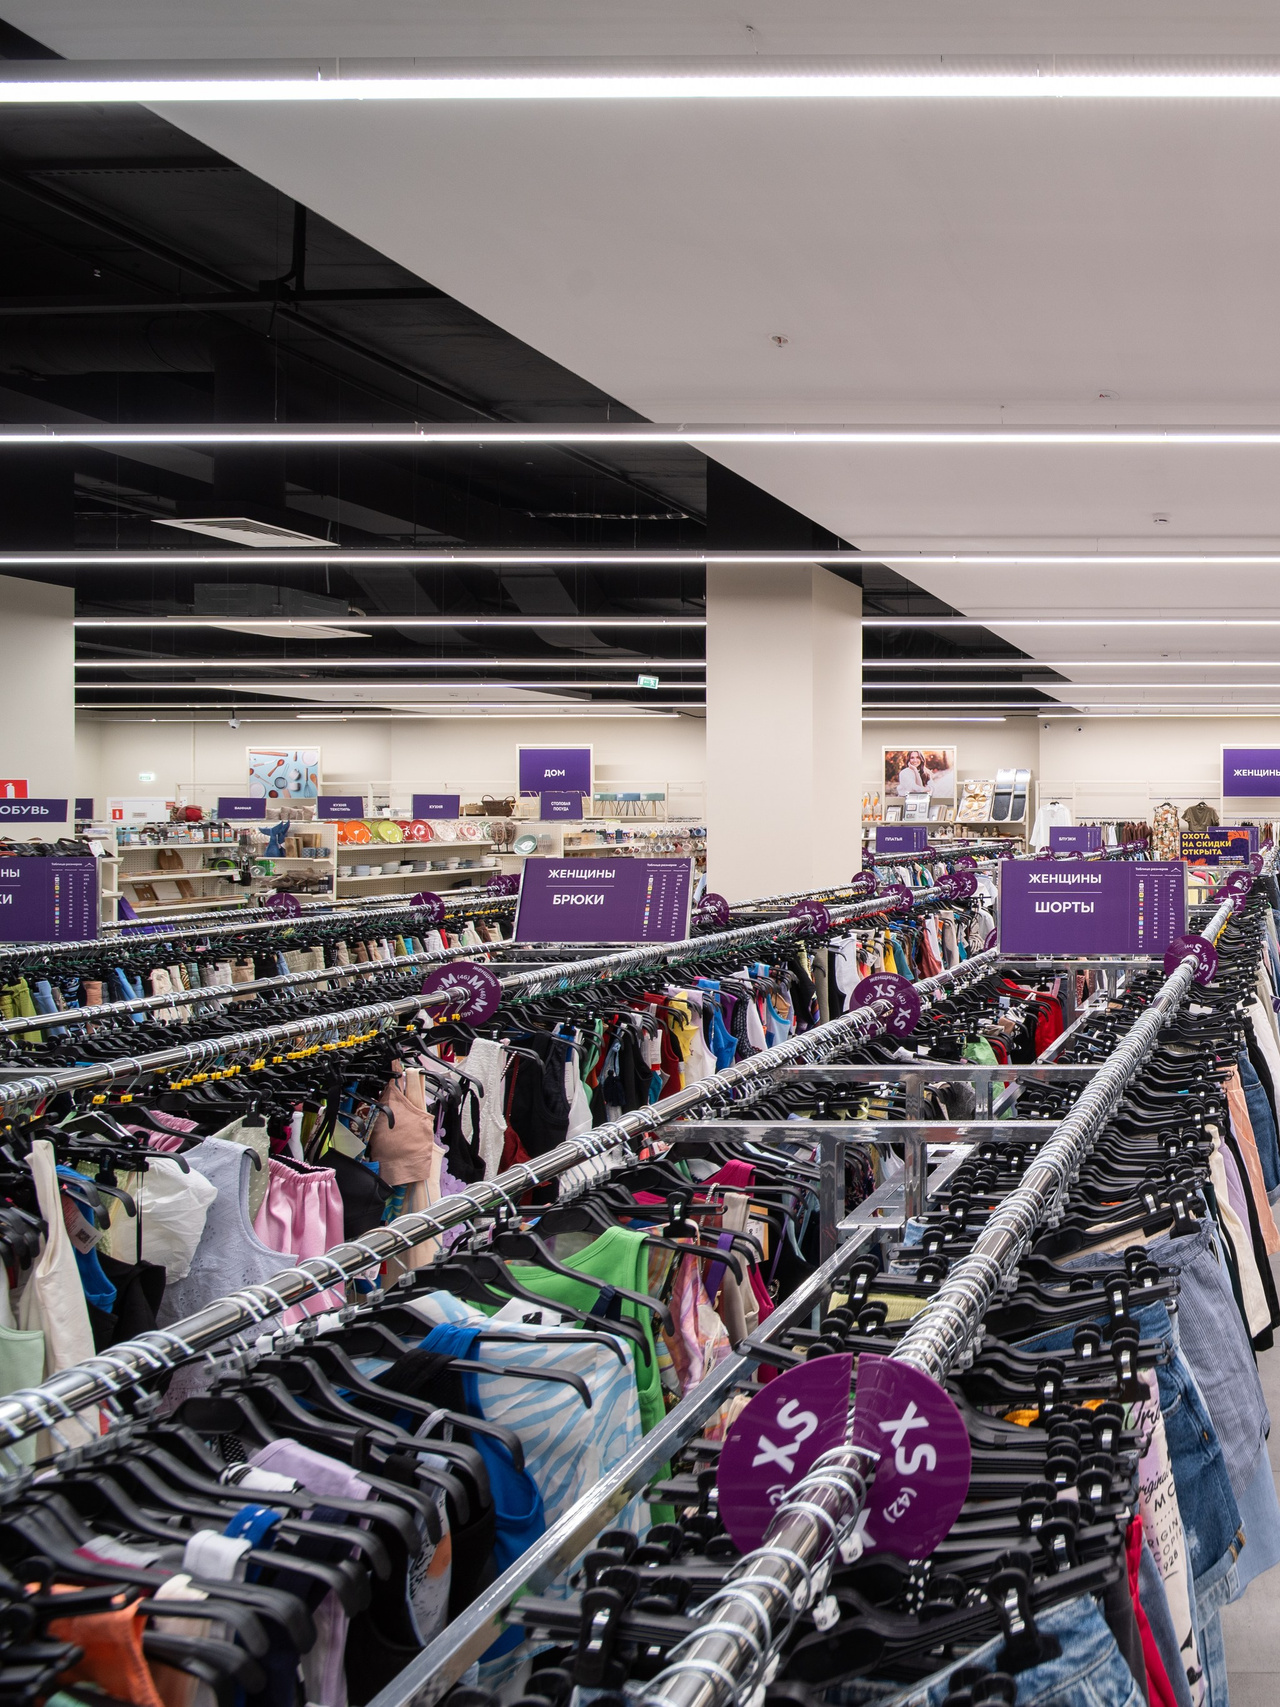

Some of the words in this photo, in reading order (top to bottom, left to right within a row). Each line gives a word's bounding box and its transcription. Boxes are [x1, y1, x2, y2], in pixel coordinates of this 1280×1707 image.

[544, 769, 566, 778] ДОМ
[0, 805, 50, 816] ОБУВЬ
[548, 869, 616, 880] ЖЕНЩИНЫ
[1028, 873, 1102, 885] ЖЕНЩИНЫ
[552, 894, 605, 905] БРЮКИ
[1035, 901, 1095, 913] ШОРТЫ
[1192, 943, 1202, 953] S
[1200, 963, 1209, 971] S
[441, 973, 458, 988] M
[467, 975, 485, 990] M
[874, 984, 896, 998] XS
[863, 993, 873, 1004] (42)
[896, 993, 906, 1004] (42)
[471, 998, 488, 1013] M
[893, 1008, 911, 1030] XS
[752, 1399, 818, 1474] XS
[878, 1401, 937, 1475] XS
[882, 1487, 917, 1523] (42)
